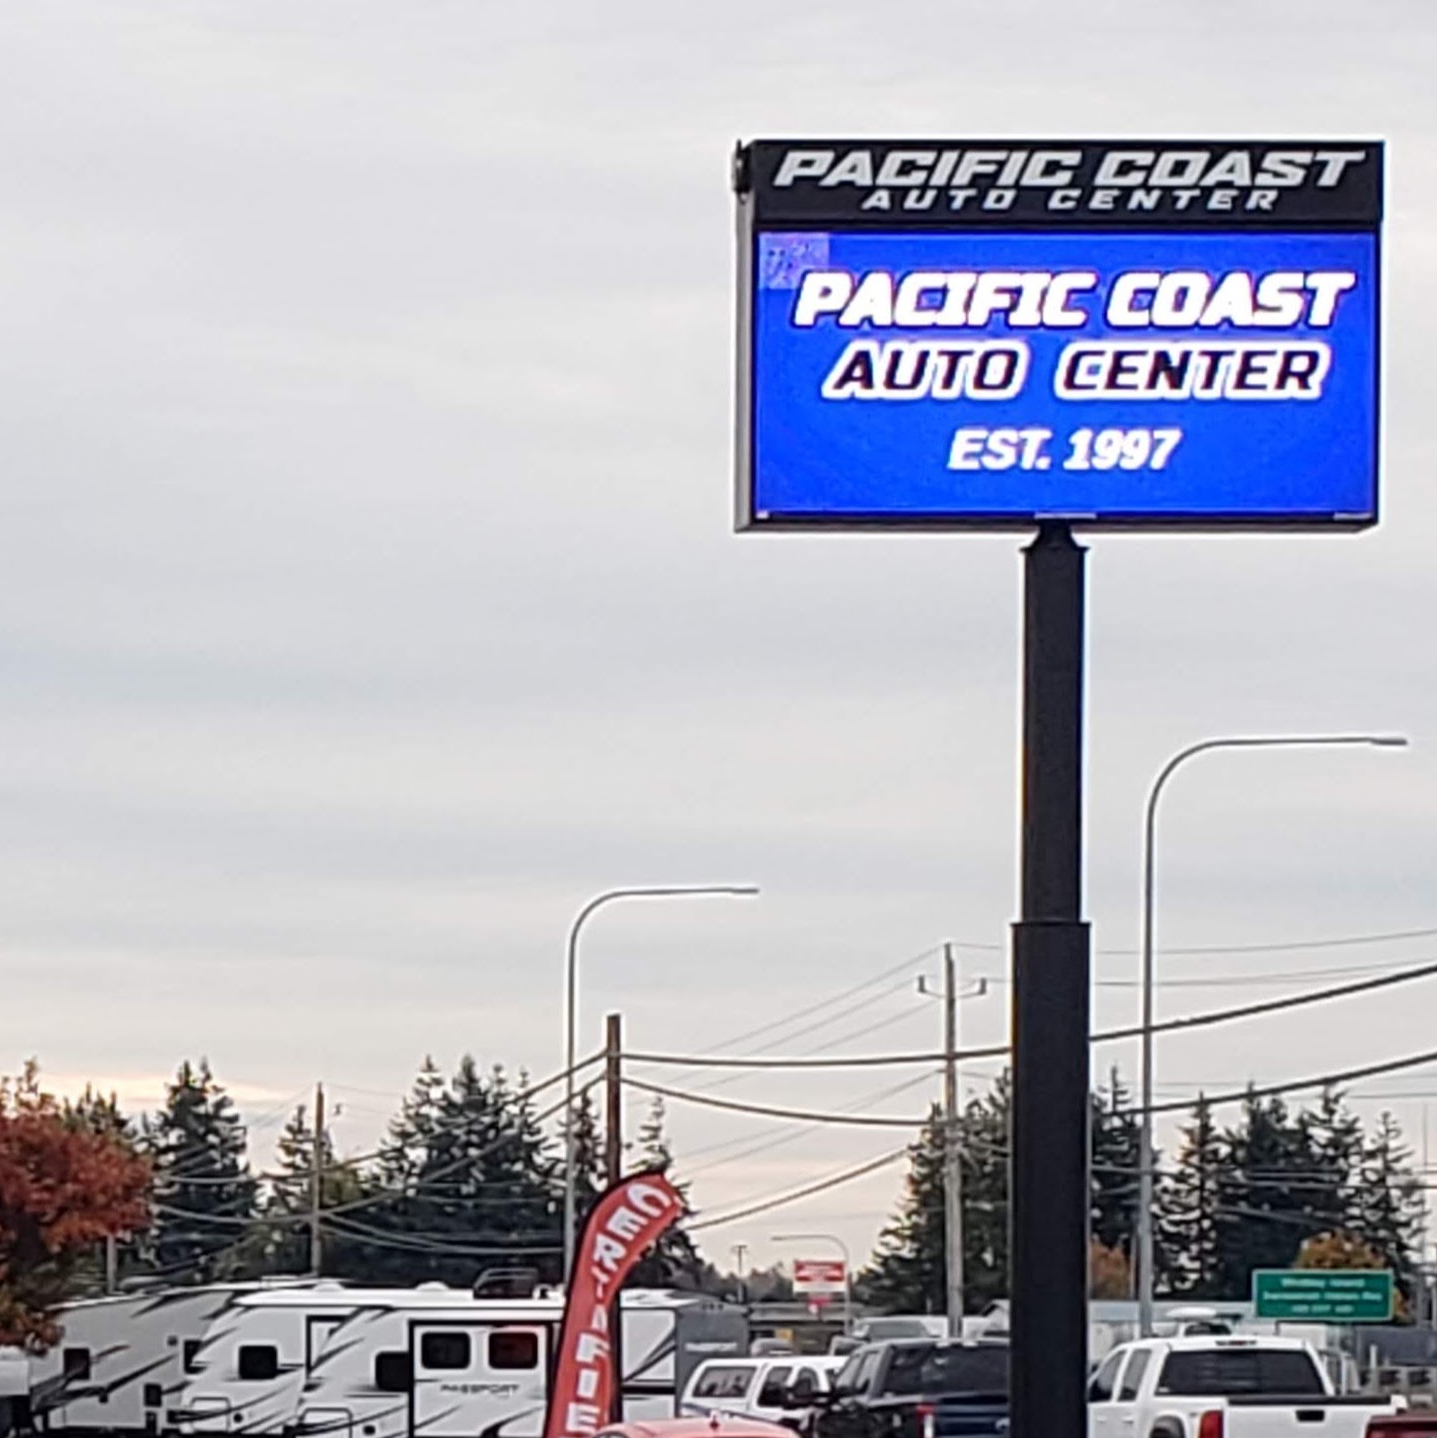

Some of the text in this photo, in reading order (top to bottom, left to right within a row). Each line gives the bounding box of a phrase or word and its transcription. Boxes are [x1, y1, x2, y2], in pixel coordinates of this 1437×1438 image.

[772, 151, 1366, 187] PACIFIC COAST
[861, 189, 1279, 210] AUTO CENTER
[794, 272, 1355, 328] PACIFIC COAST
[829, 345, 1324, 395] AUTO CENTER
[947, 428, 1183, 470] EST. 1997
